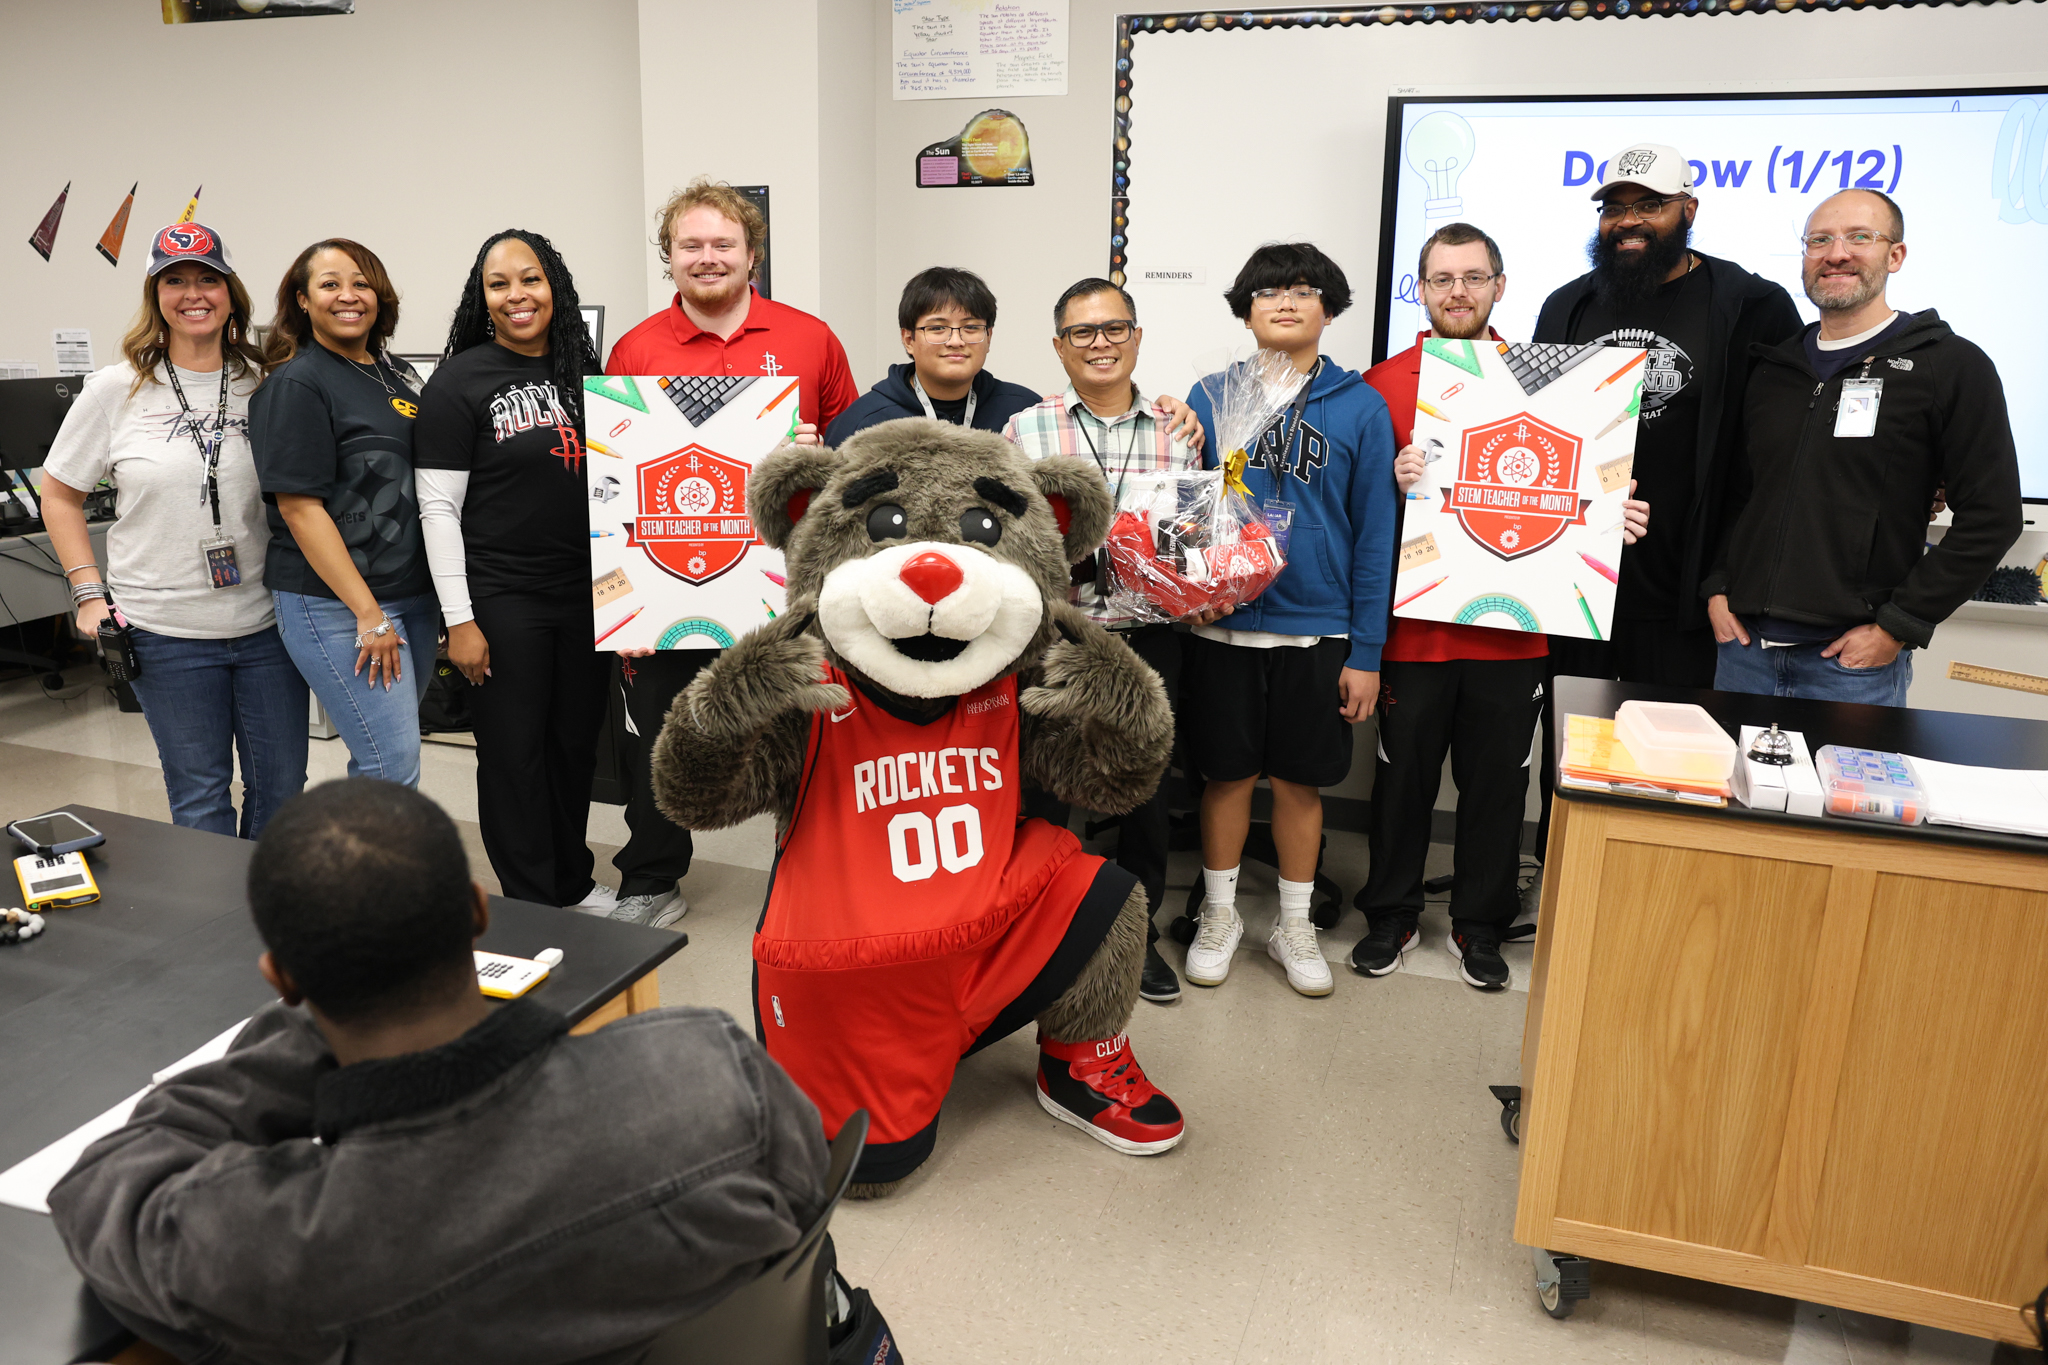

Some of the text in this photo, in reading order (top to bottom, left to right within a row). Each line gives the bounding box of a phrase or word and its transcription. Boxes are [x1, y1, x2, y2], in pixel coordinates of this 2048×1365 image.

[1691, 159, 1753, 188] ow
[1767, 145, 1902, 194] (1/12)
[1145, 271, 1193, 279] REMINDERS
[490, 384, 574, 444] ROCK
[1458, 486, 1573, 512] STEM TEACHER OF THE MONTH
[334, 510, 366, 525] elers
[641, 520, 750, 536] STEM TEACHER OF THE MONTH
[1426, 545, 1434, 553] 20
[618, 579, 625, 587] 20
[853, 747, 1003, 814] ROCKETS
[887, 803, 984, 882] 00
[1096, 1029, 1126, 1058] CLUT
